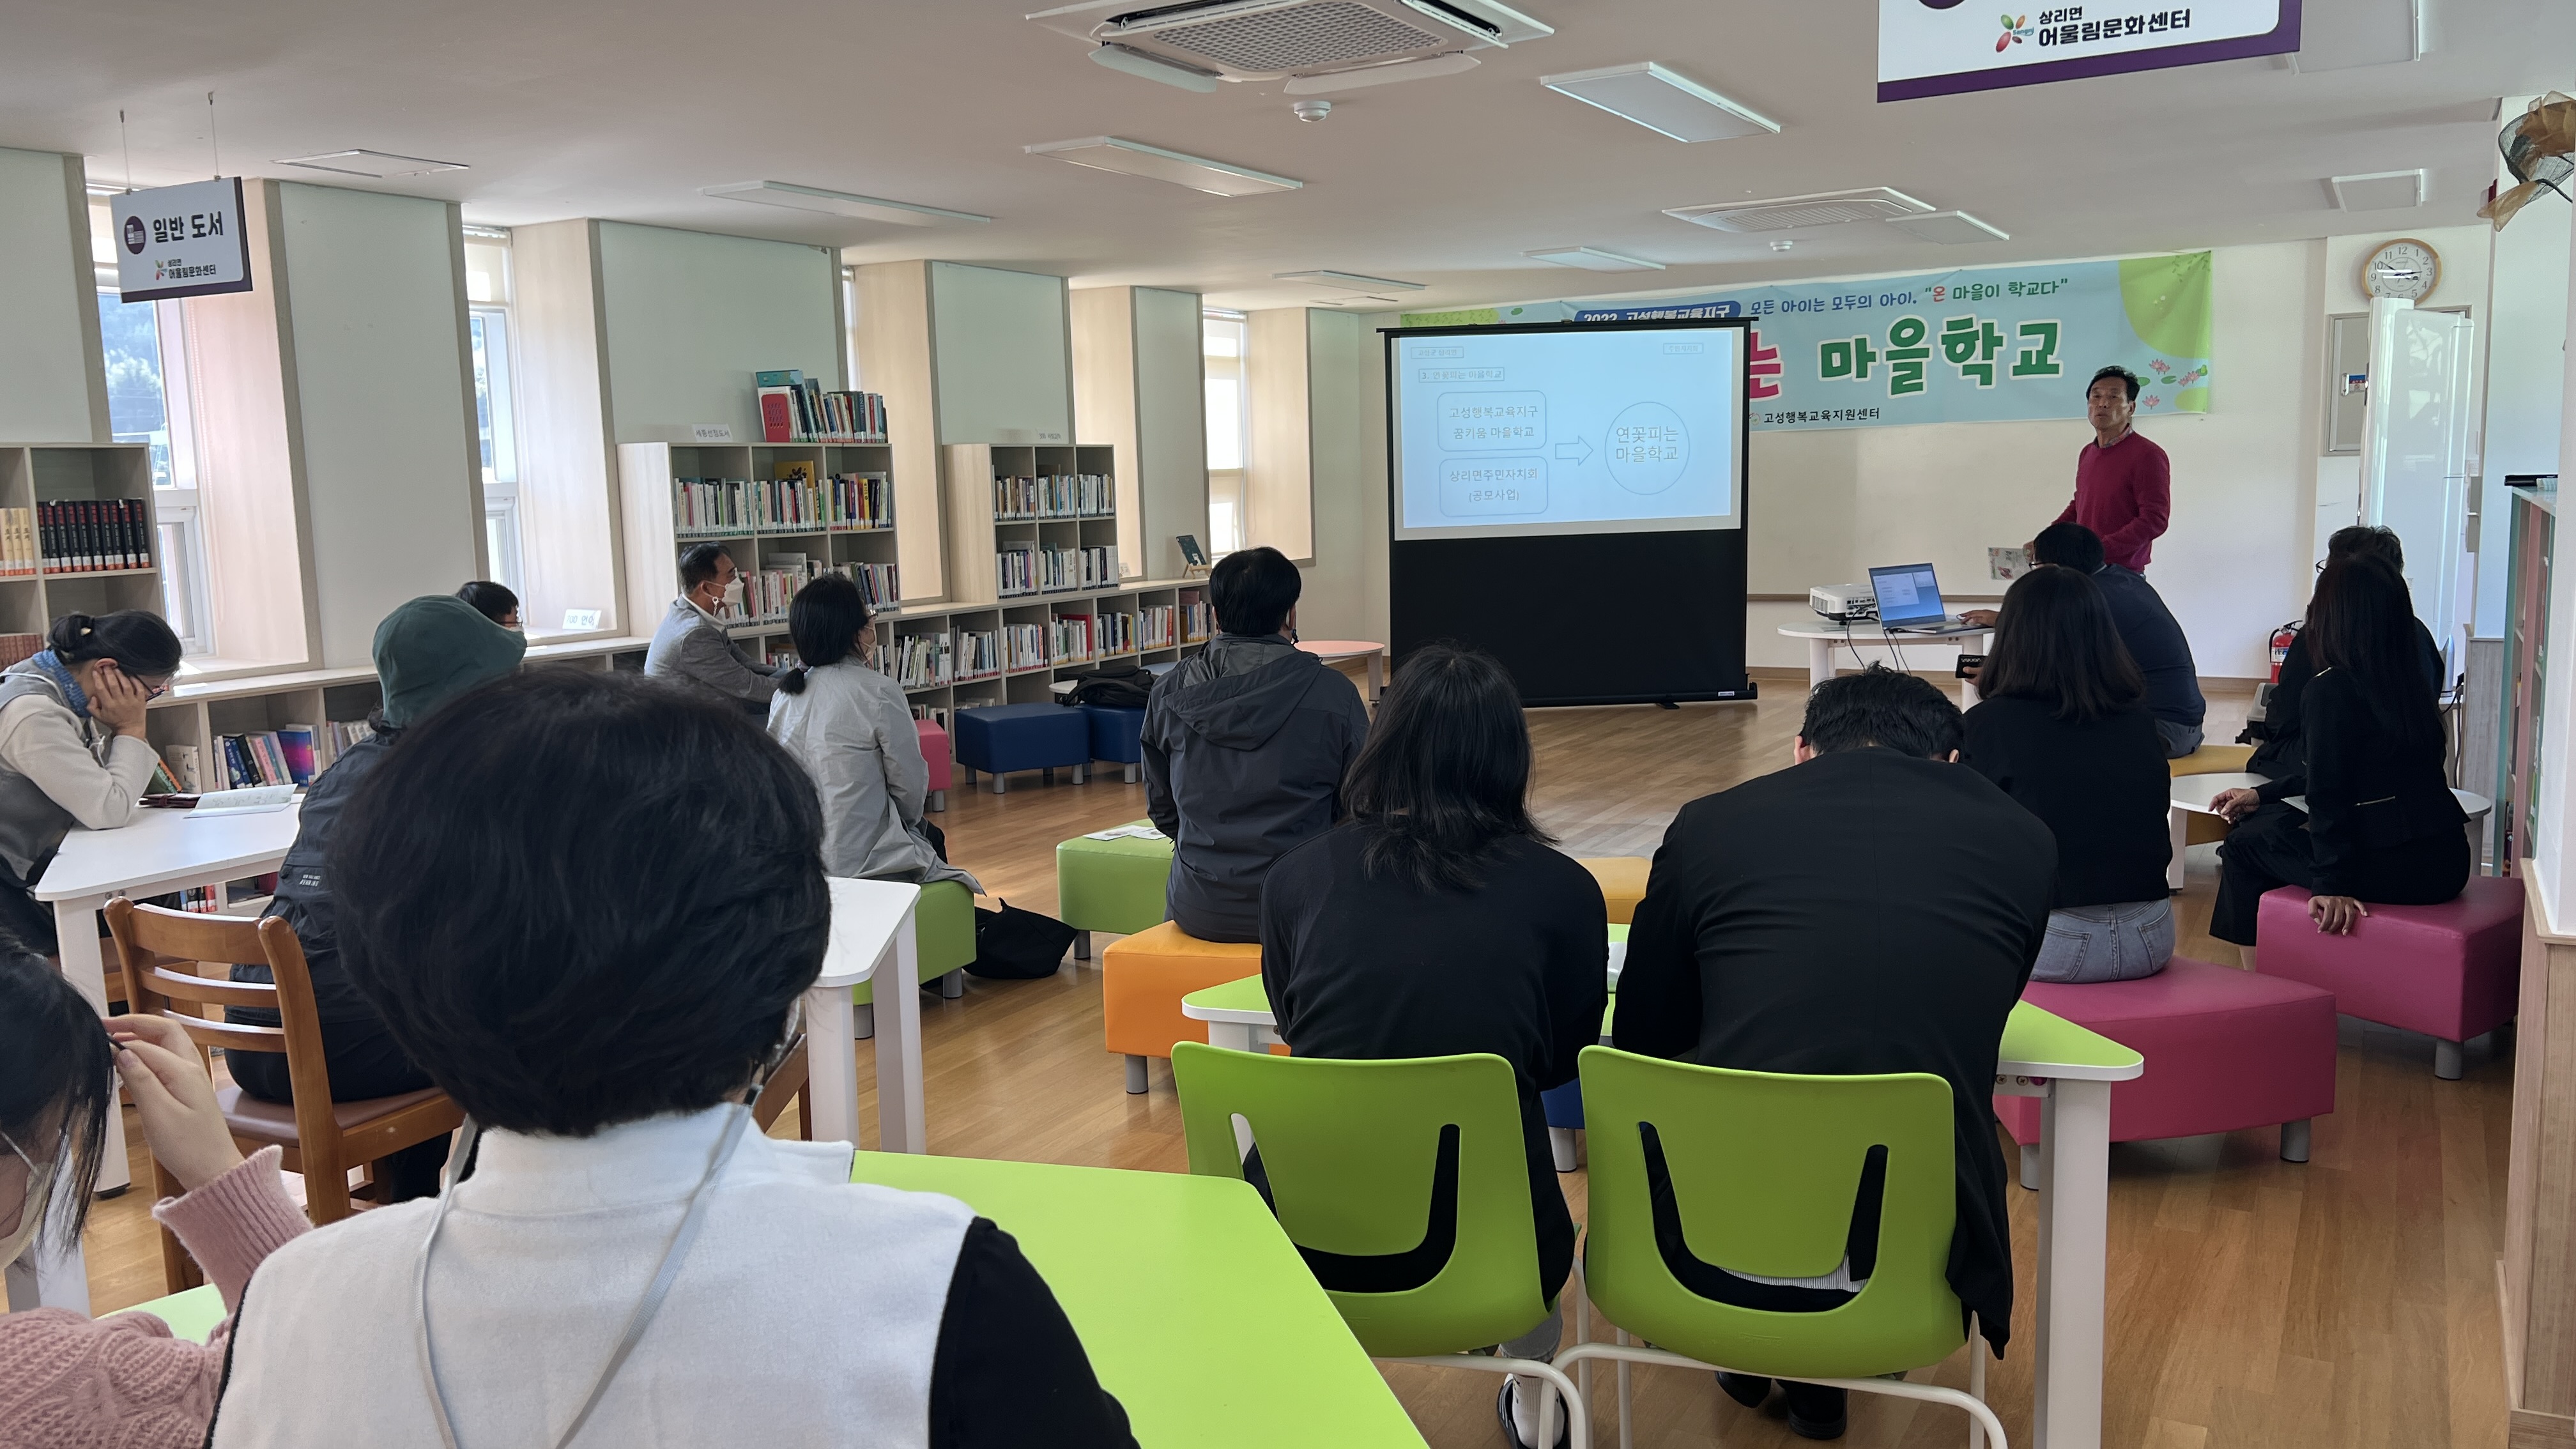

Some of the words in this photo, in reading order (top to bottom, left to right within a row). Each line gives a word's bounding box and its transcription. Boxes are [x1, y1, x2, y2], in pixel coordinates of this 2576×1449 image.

[2039, 6, 2083, 25] 상리면
[2039, 8, 2190, 47] 어울림문화센터
[153, 216, 184, 243] 일반
[191, 211, 224, 238] 도서
[2385, 251, 2392, 259] 11
[2416, 249, 2419, 257] 1
[2374, 261, 2383, 270] 10
[2423, 257, 2429, 265] 2
[169, 264, 216, 279] 어울림문화센터
[2426, 268, 2432, 276] 3
[1751, 300, 1774, 315] 모든
[1781, 298, 1824, 314] 아이는
[1832, 294, 1873, 311] 모두의
[1880, 291, 1917, 307] 아이.
[1952, 283, 2000, 302] 마을이
[2411, 289, 2418, 298] 5
[1819, 316, 2061, 397] 마을학교
[1432, 371, 1466, 380] 연꽃피는
[1469, 370, 1503, 379] 마을학교
[1449, 406, 1538, 418] 고성행복교육지구
[1763, 408, 1880, 424] 고성행복교육지원센터
[1453, 427, 1487, 440] 꿈키움
[1491, 426, 1535, 438] 마을학교
[1616, 425, 1679, 444] 연꽃피는
[1616, 445, 1679, 463] 마을학교
[1450, 468, 1538, 482] 상리면주민자치회
[1468, 489, 1520, 503] (공모사업)
[566, 615, 578, 624] 700
